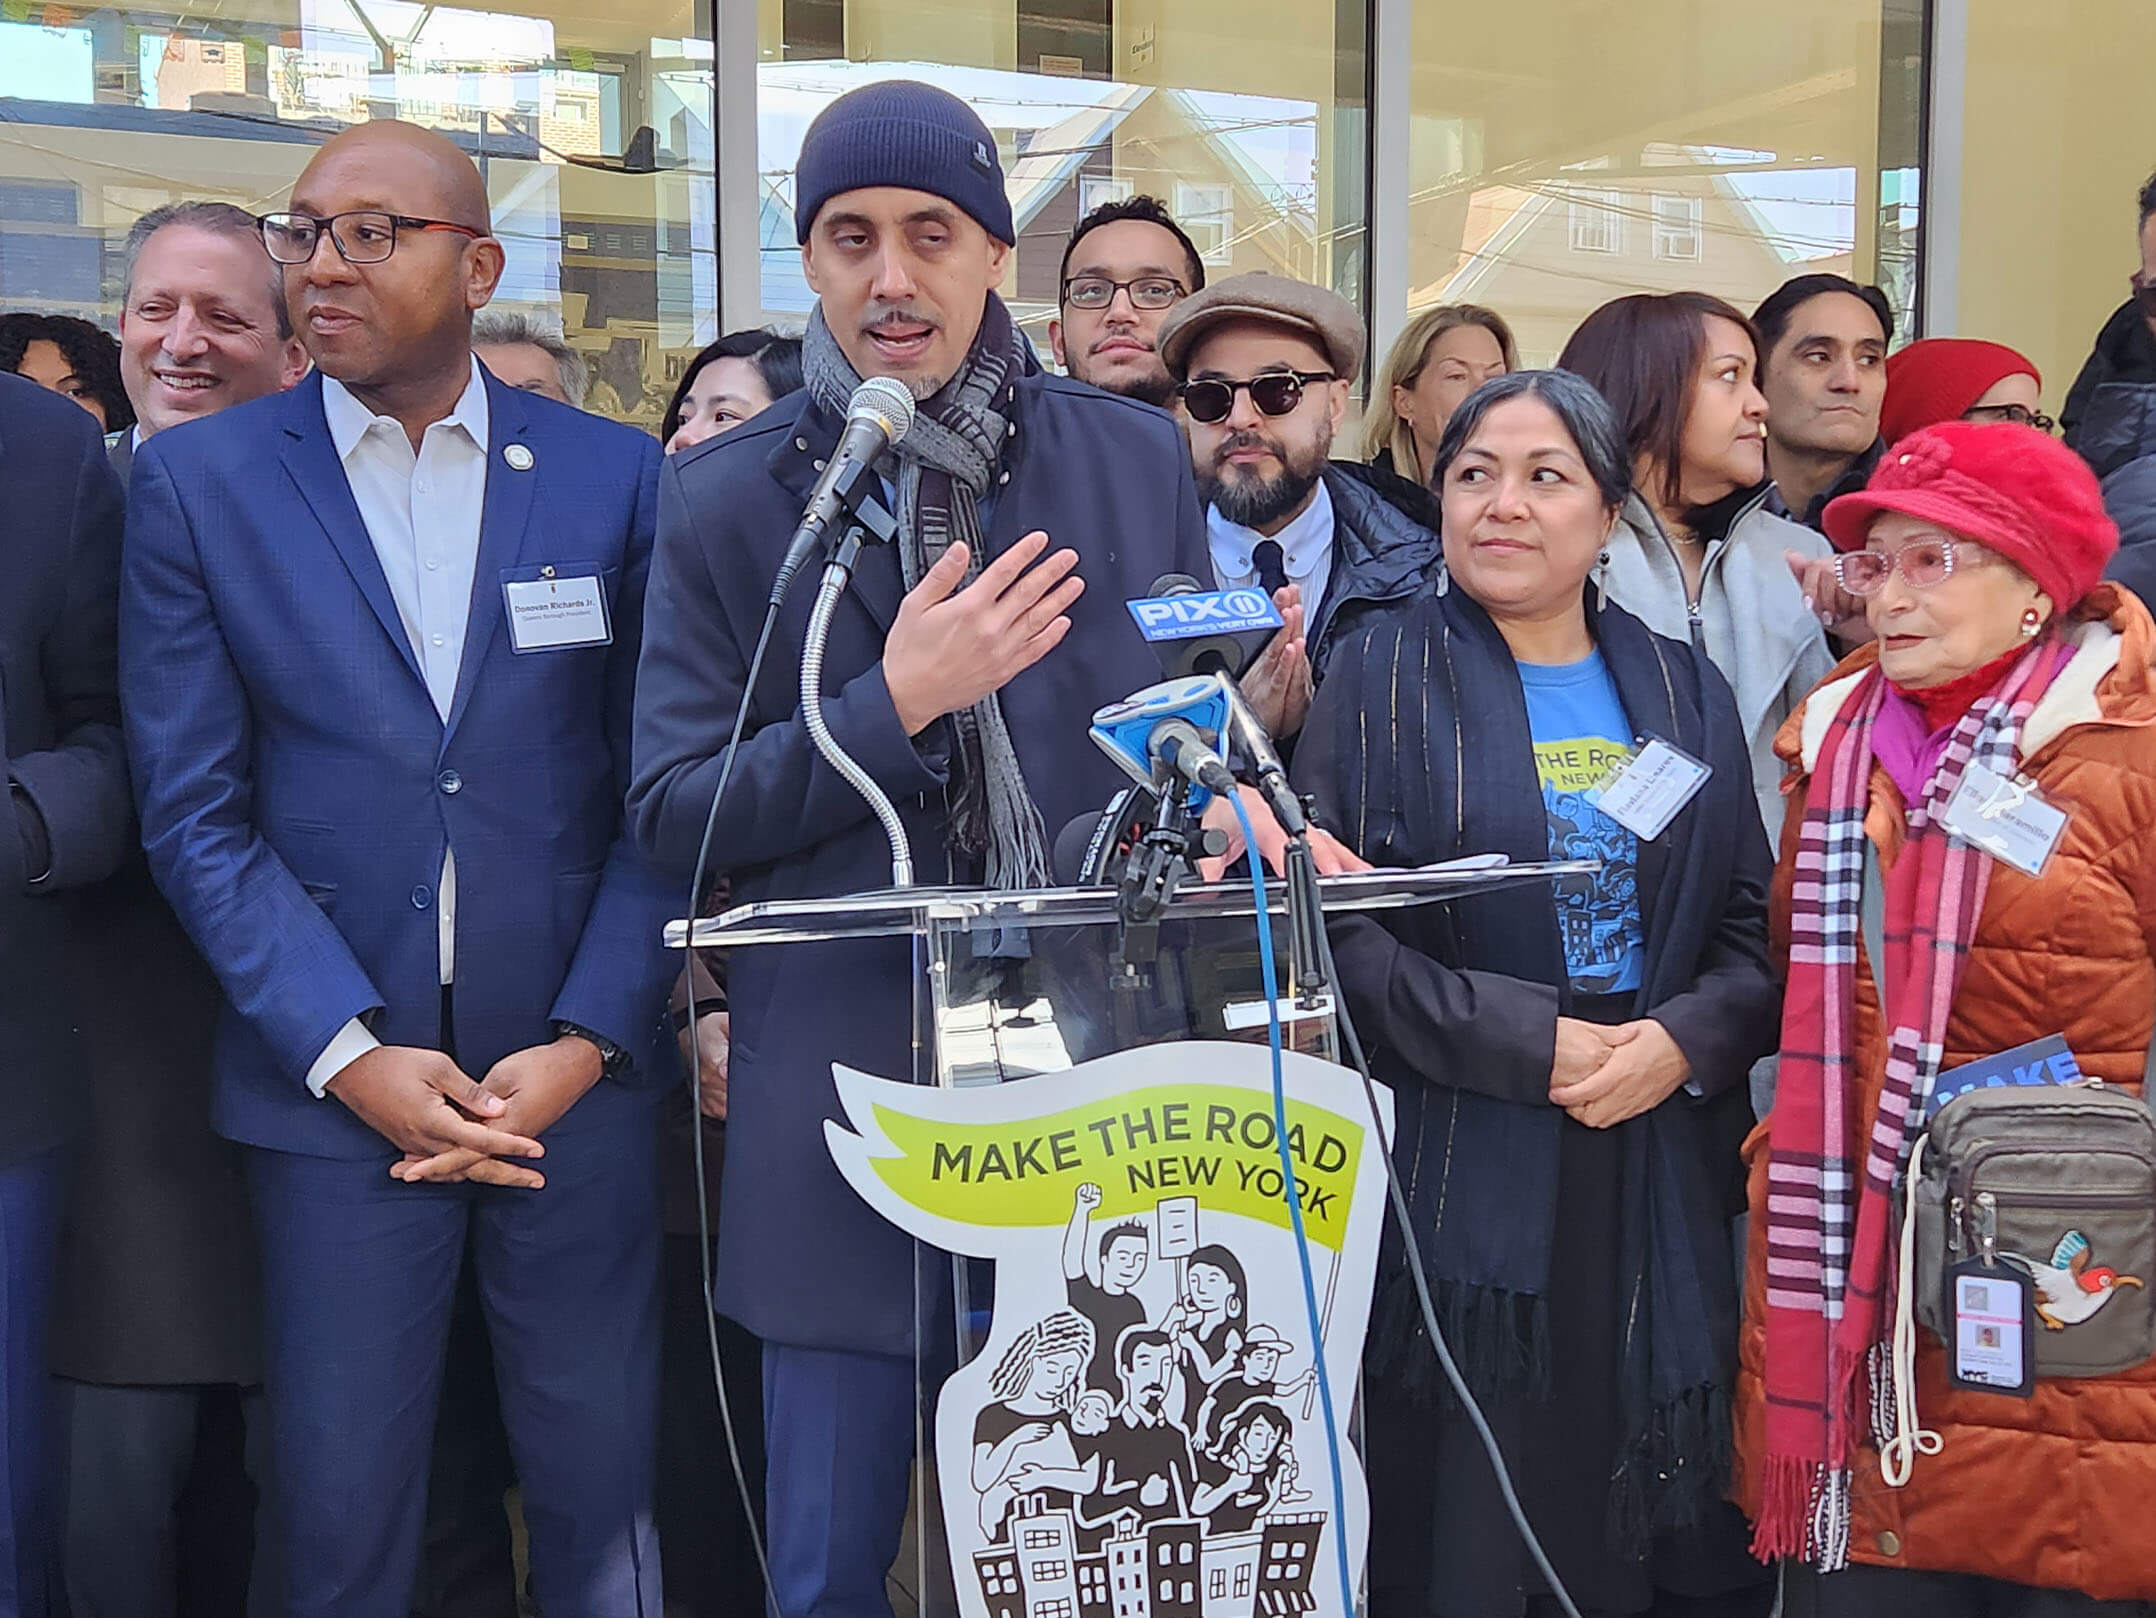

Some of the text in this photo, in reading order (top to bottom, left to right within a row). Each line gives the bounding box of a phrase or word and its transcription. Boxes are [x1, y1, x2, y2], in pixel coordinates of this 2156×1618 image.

[1534, 750, 1581, 769] THE
[931, 1103, 1349, 1183] MAKE THE ROAD
[1127, 1156, 1338, 1221] NEW YORK
